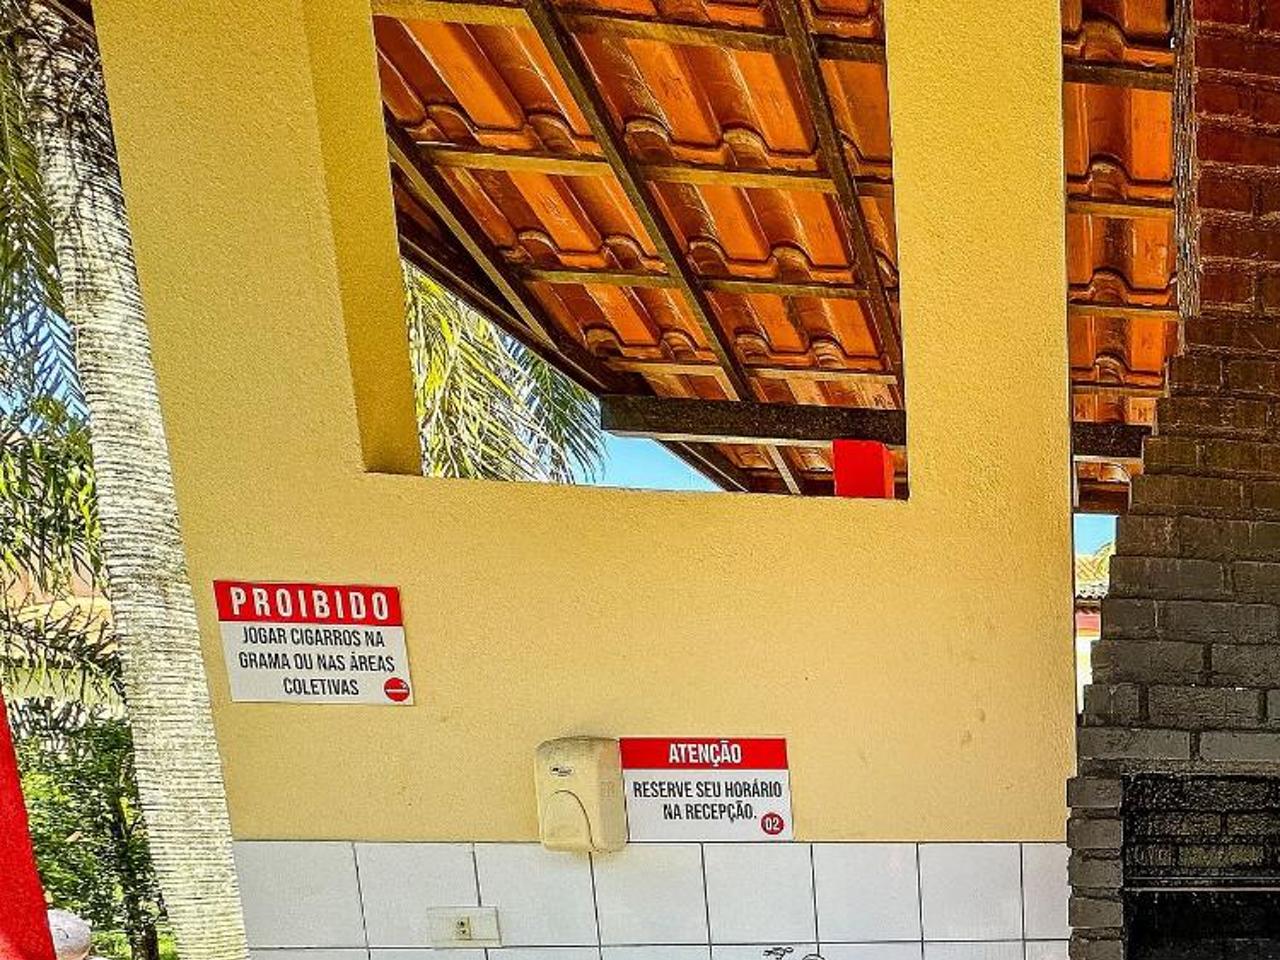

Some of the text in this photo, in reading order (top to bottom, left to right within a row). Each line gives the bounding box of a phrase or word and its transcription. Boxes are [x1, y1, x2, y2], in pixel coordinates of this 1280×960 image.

[230, 586, 389, 620] PROIBIDO
[242, 626, 385, 648] JOGAR CIGARROS NA
[238, 651, 395, 673] GRAMA OU NAS ÁREAS
[283, 676, 359, 696] COLETIVAS
[668, 740, 742, 767] ATENÇÃO
[633, 778, 782, 798] RESERVE SEU HORÁRIO
[663, 800, 758, 823] NA RECEPÇÃO.
[764, 817, 780, 832] 02
